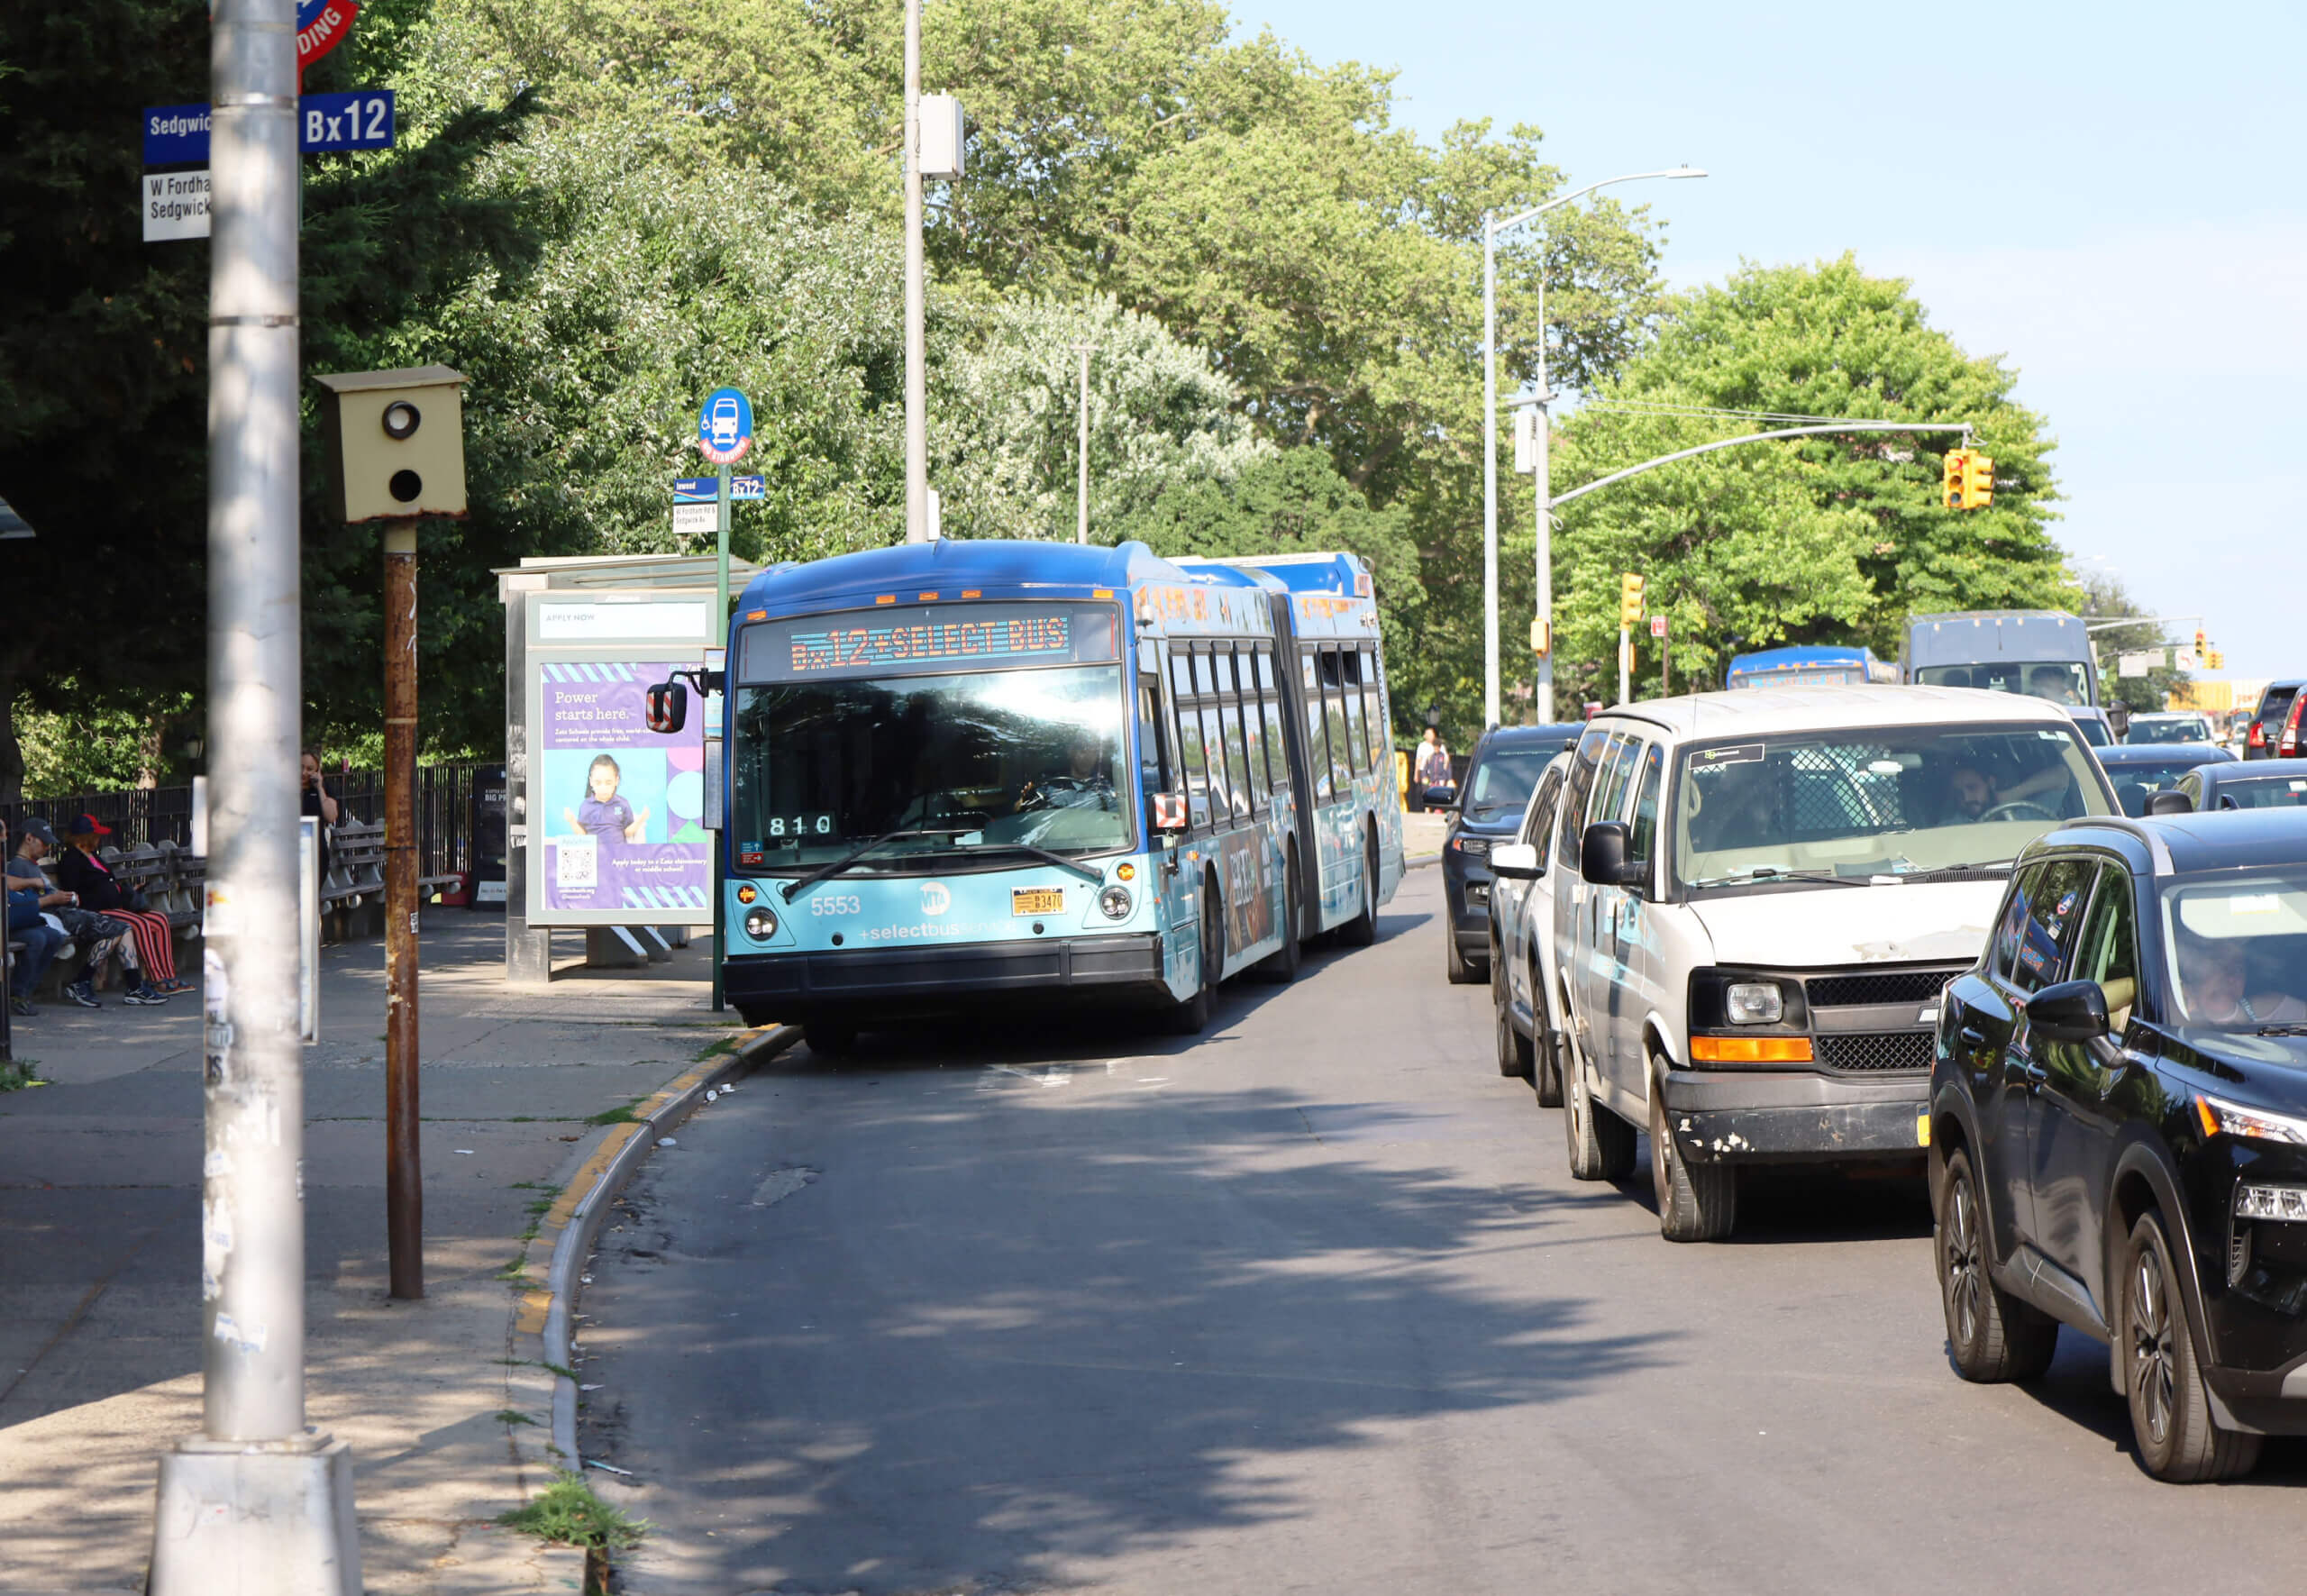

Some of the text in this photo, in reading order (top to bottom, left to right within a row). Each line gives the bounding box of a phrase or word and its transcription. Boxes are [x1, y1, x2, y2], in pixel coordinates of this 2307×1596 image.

[296, 6, 342, 56] DING
[150, 114, 211, 137] Sedgwic
[306, 97, 387, 143] Bx12
[150, 176, 210, 196] W Fordha
[733, 479, 759, 497] Bx12
[546, 614, 571, 622] APPLY
[1008, 617, 1065, 651] BUS
[554, 691, 598, 704] Power
[554, 707, 630, 721] starts here.
[485, 793, 497, 801] BIG
[810, 895, 862, 917] 5553
